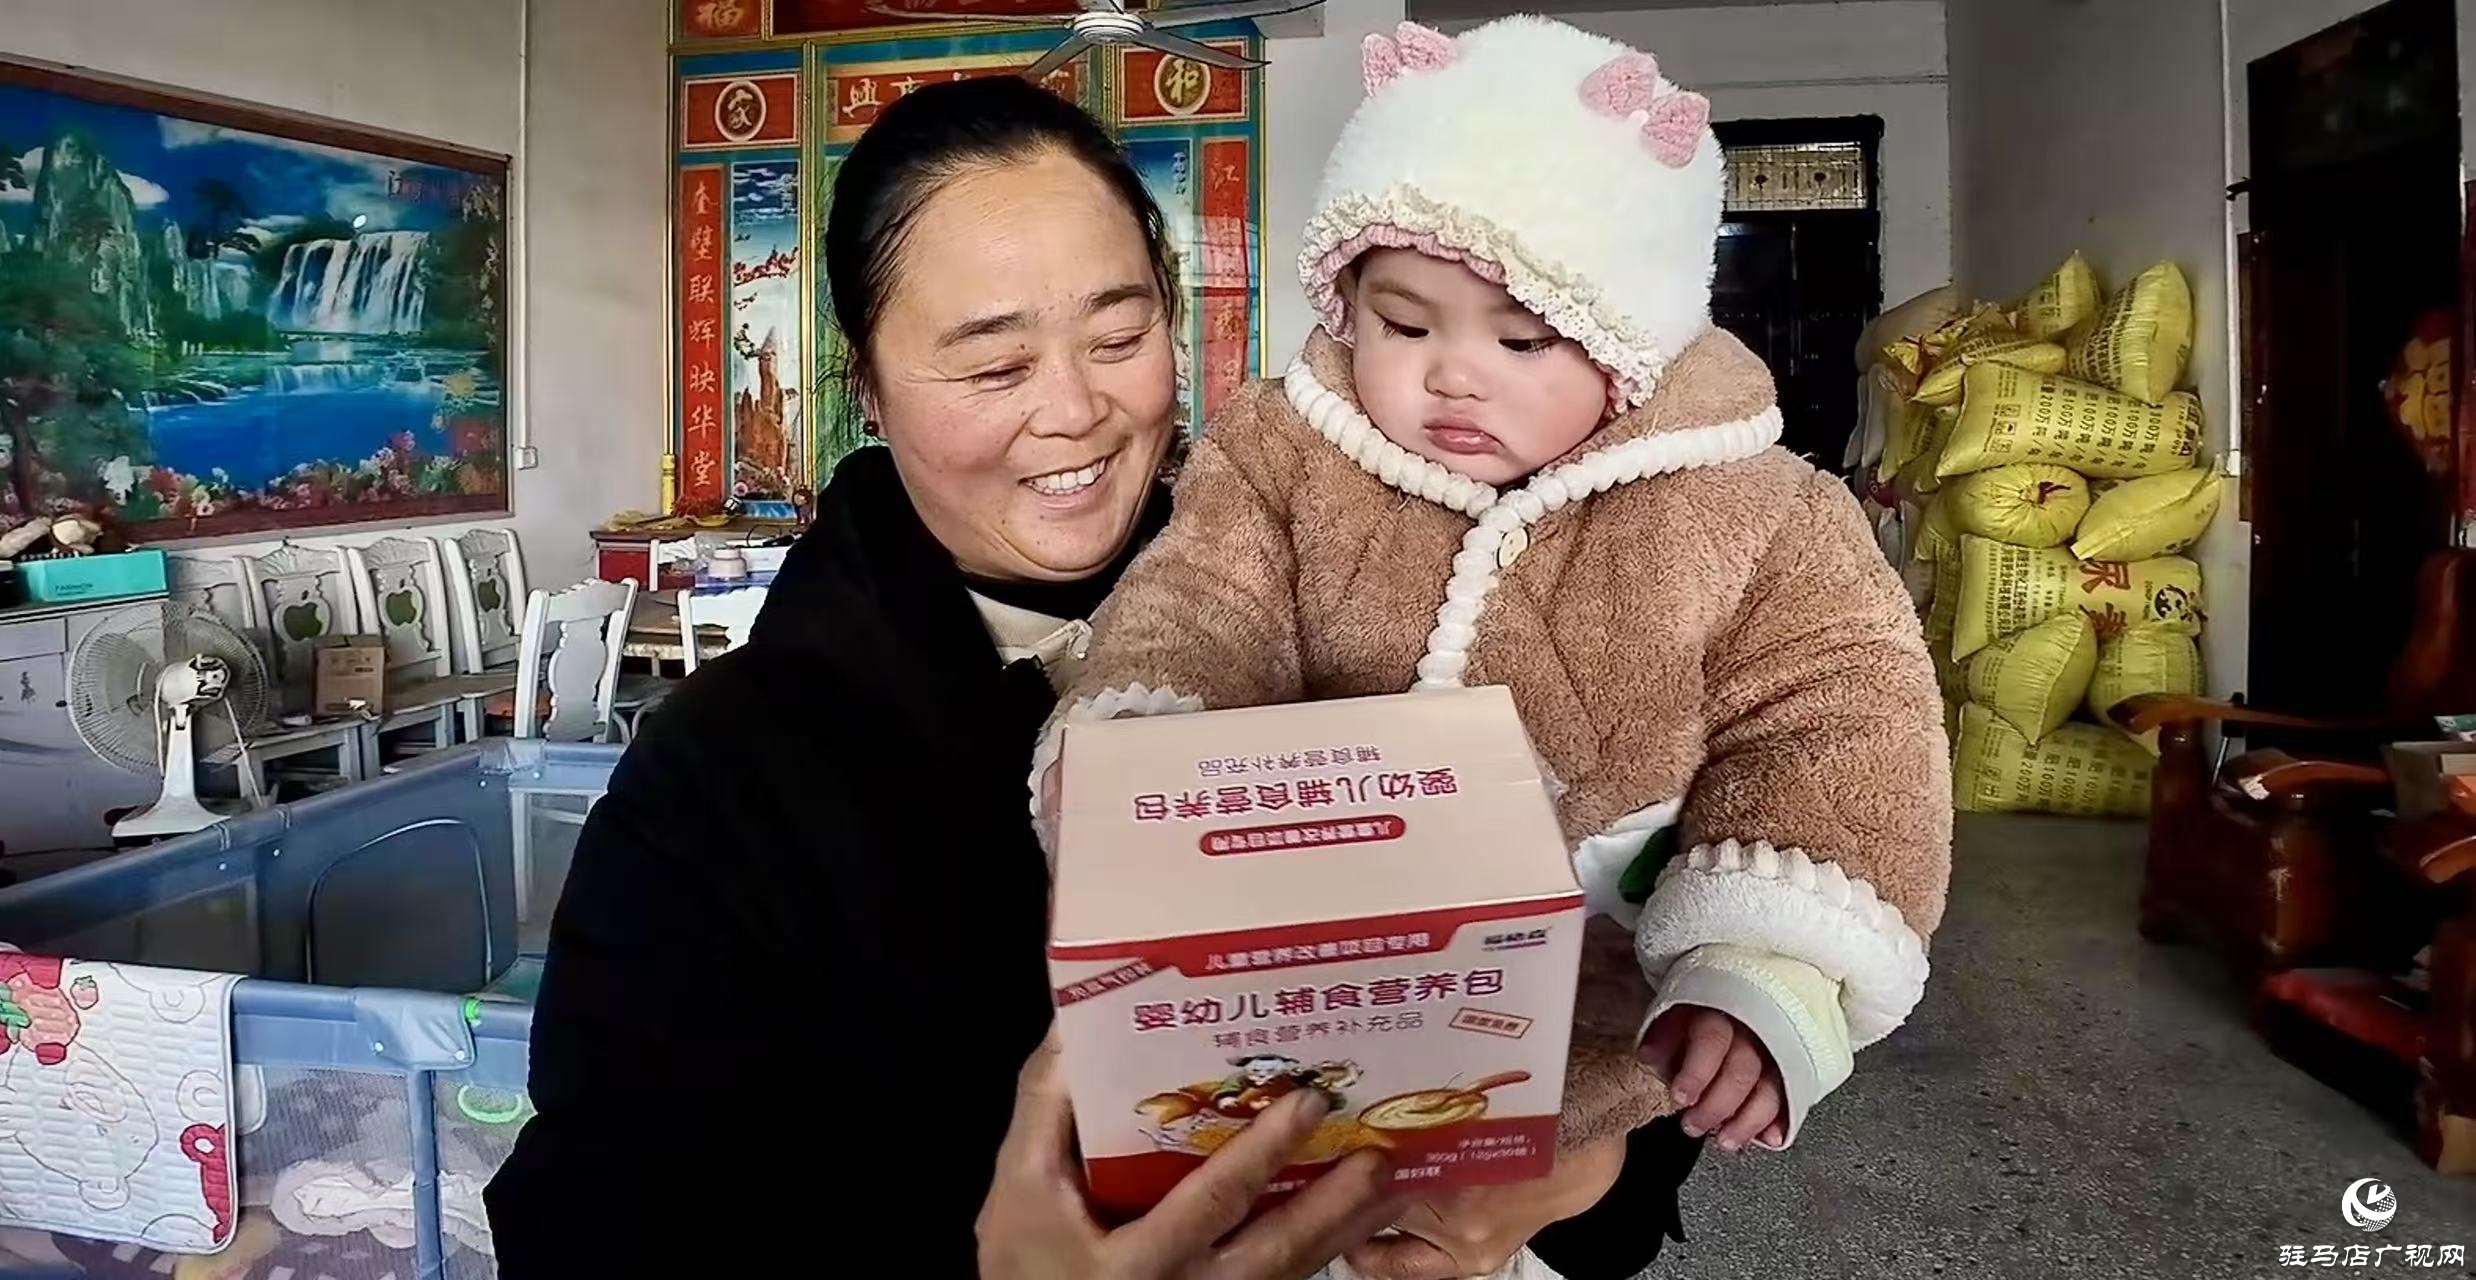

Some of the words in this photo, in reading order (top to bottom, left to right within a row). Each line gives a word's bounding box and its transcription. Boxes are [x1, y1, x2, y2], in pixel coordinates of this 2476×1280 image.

[1165, 58, 1200, 103] 和
[1198, 745, 1382, 777] 辅食营养补充品
[1134, 767, 1459, 822] 婴幼儿辅食营养包
[1134, 969, 1504, 1031] 婴幼儿辅食营养包
[1213, 1010, 1424, 1049] 辅食营养补充品
